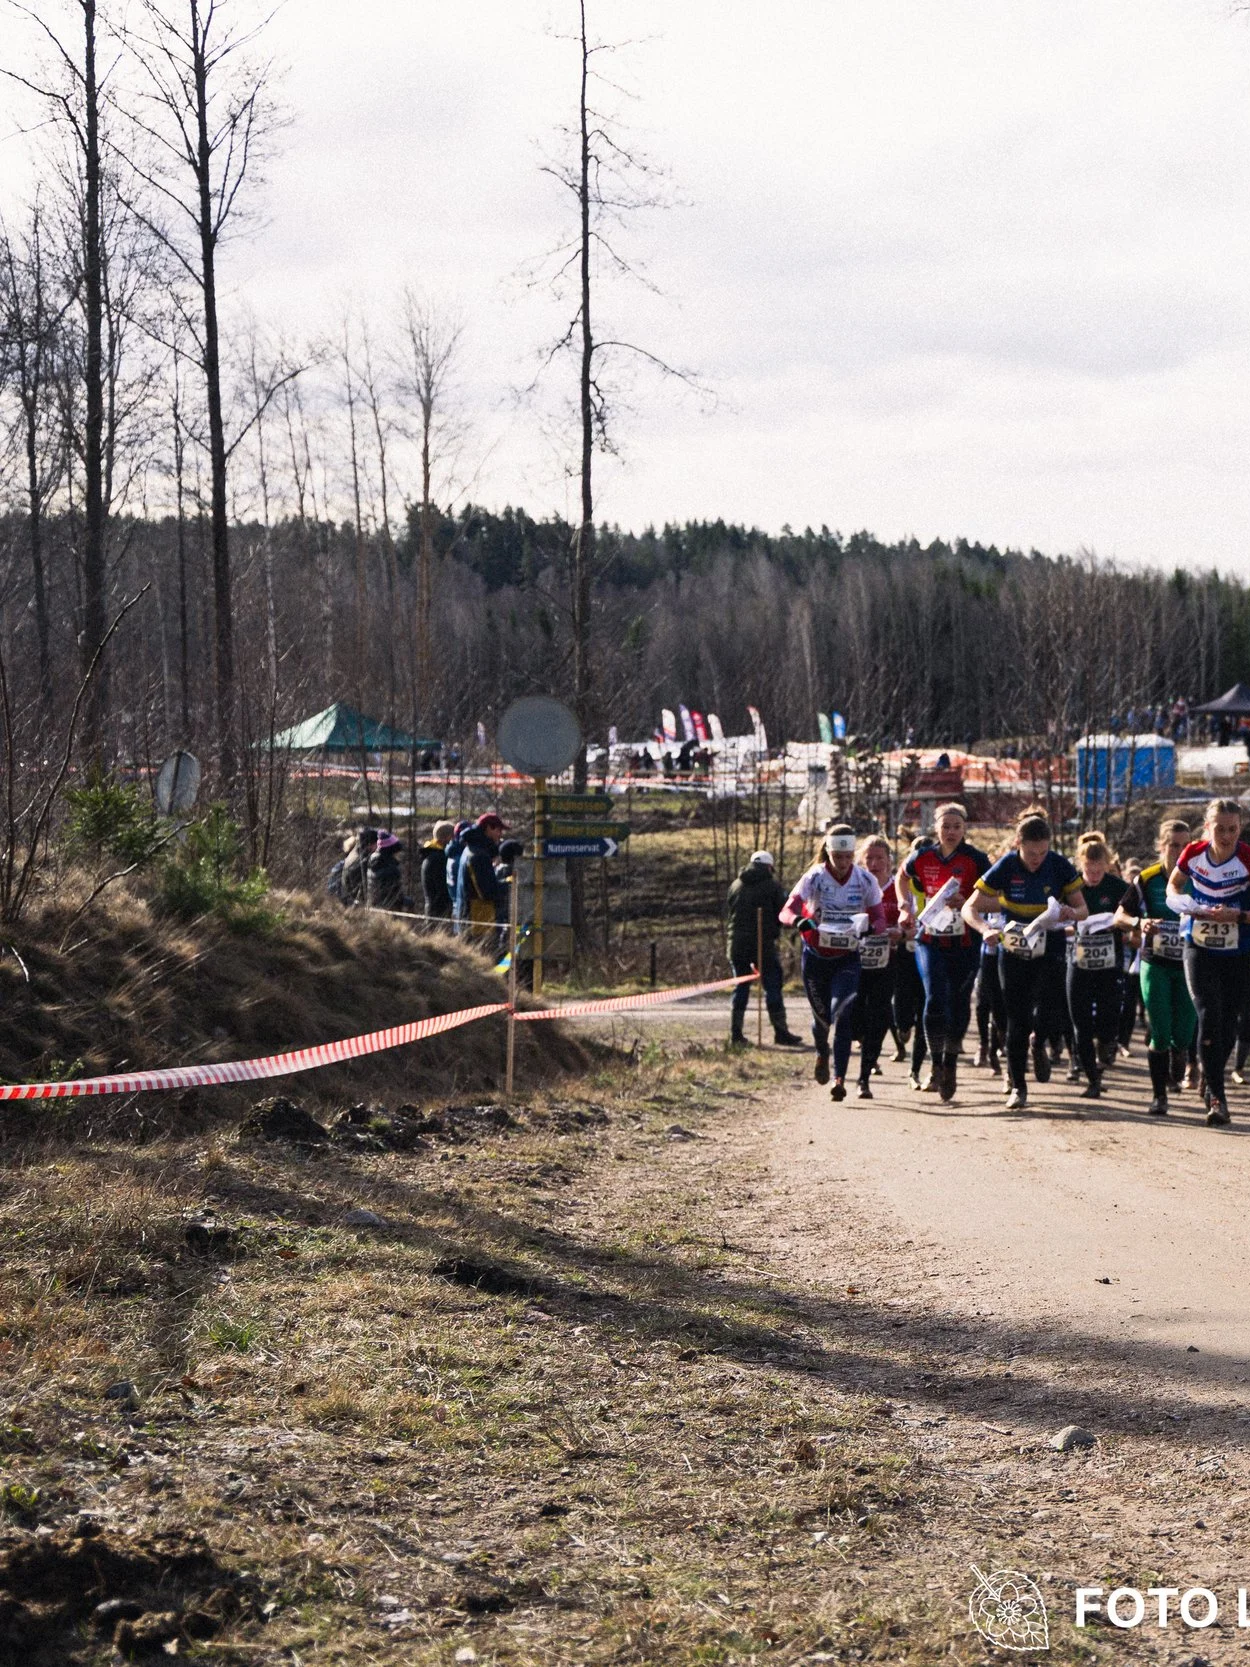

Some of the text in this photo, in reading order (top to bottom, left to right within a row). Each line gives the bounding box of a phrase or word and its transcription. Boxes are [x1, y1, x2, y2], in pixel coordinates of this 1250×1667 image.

[548, 844, 600, 853] Naturreservat
[1200, 922, 1230, 935] 213
[860, 947, 883, 957] 228
[1083, 947, 1108, 958] 204
